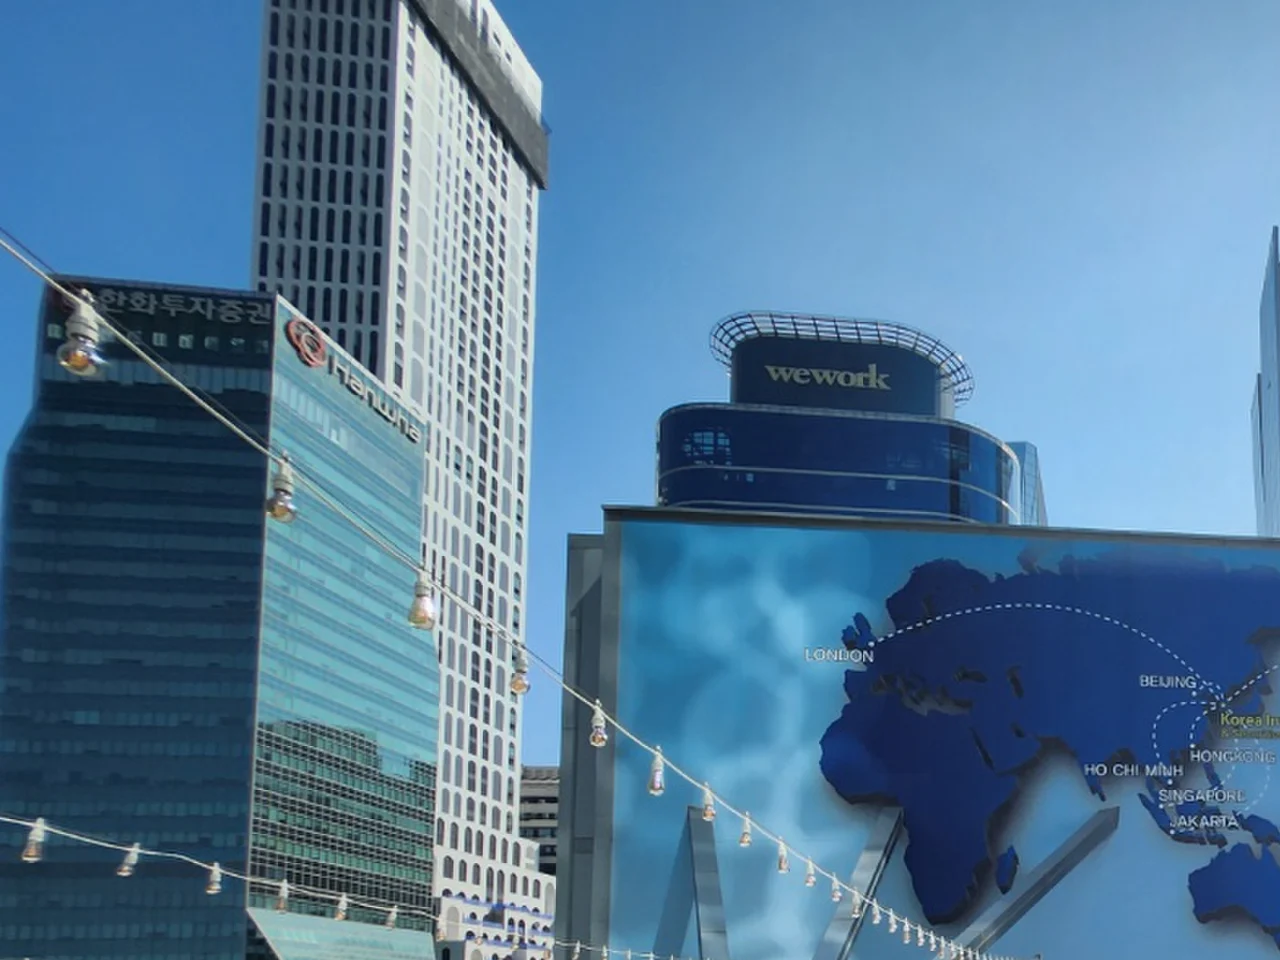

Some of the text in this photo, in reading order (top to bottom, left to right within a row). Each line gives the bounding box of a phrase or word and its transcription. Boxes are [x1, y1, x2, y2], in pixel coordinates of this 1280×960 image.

[98, 287, 272, 325] 한화투자증권
[764, 363, 892, 390] wework
[328, 354, 422, 444] Hanwha
[804, 648, 875, 663] LONDON
[1139, 674, 1197, 689] BEIJING
[1220, 712, 1263, 727] Korea
[1190, 750, 1276, 763] HONGKONG
[1084, 763, 1184, 777] HO CHI MINH
[1170, 815, 1240, 828] JAKARTA
